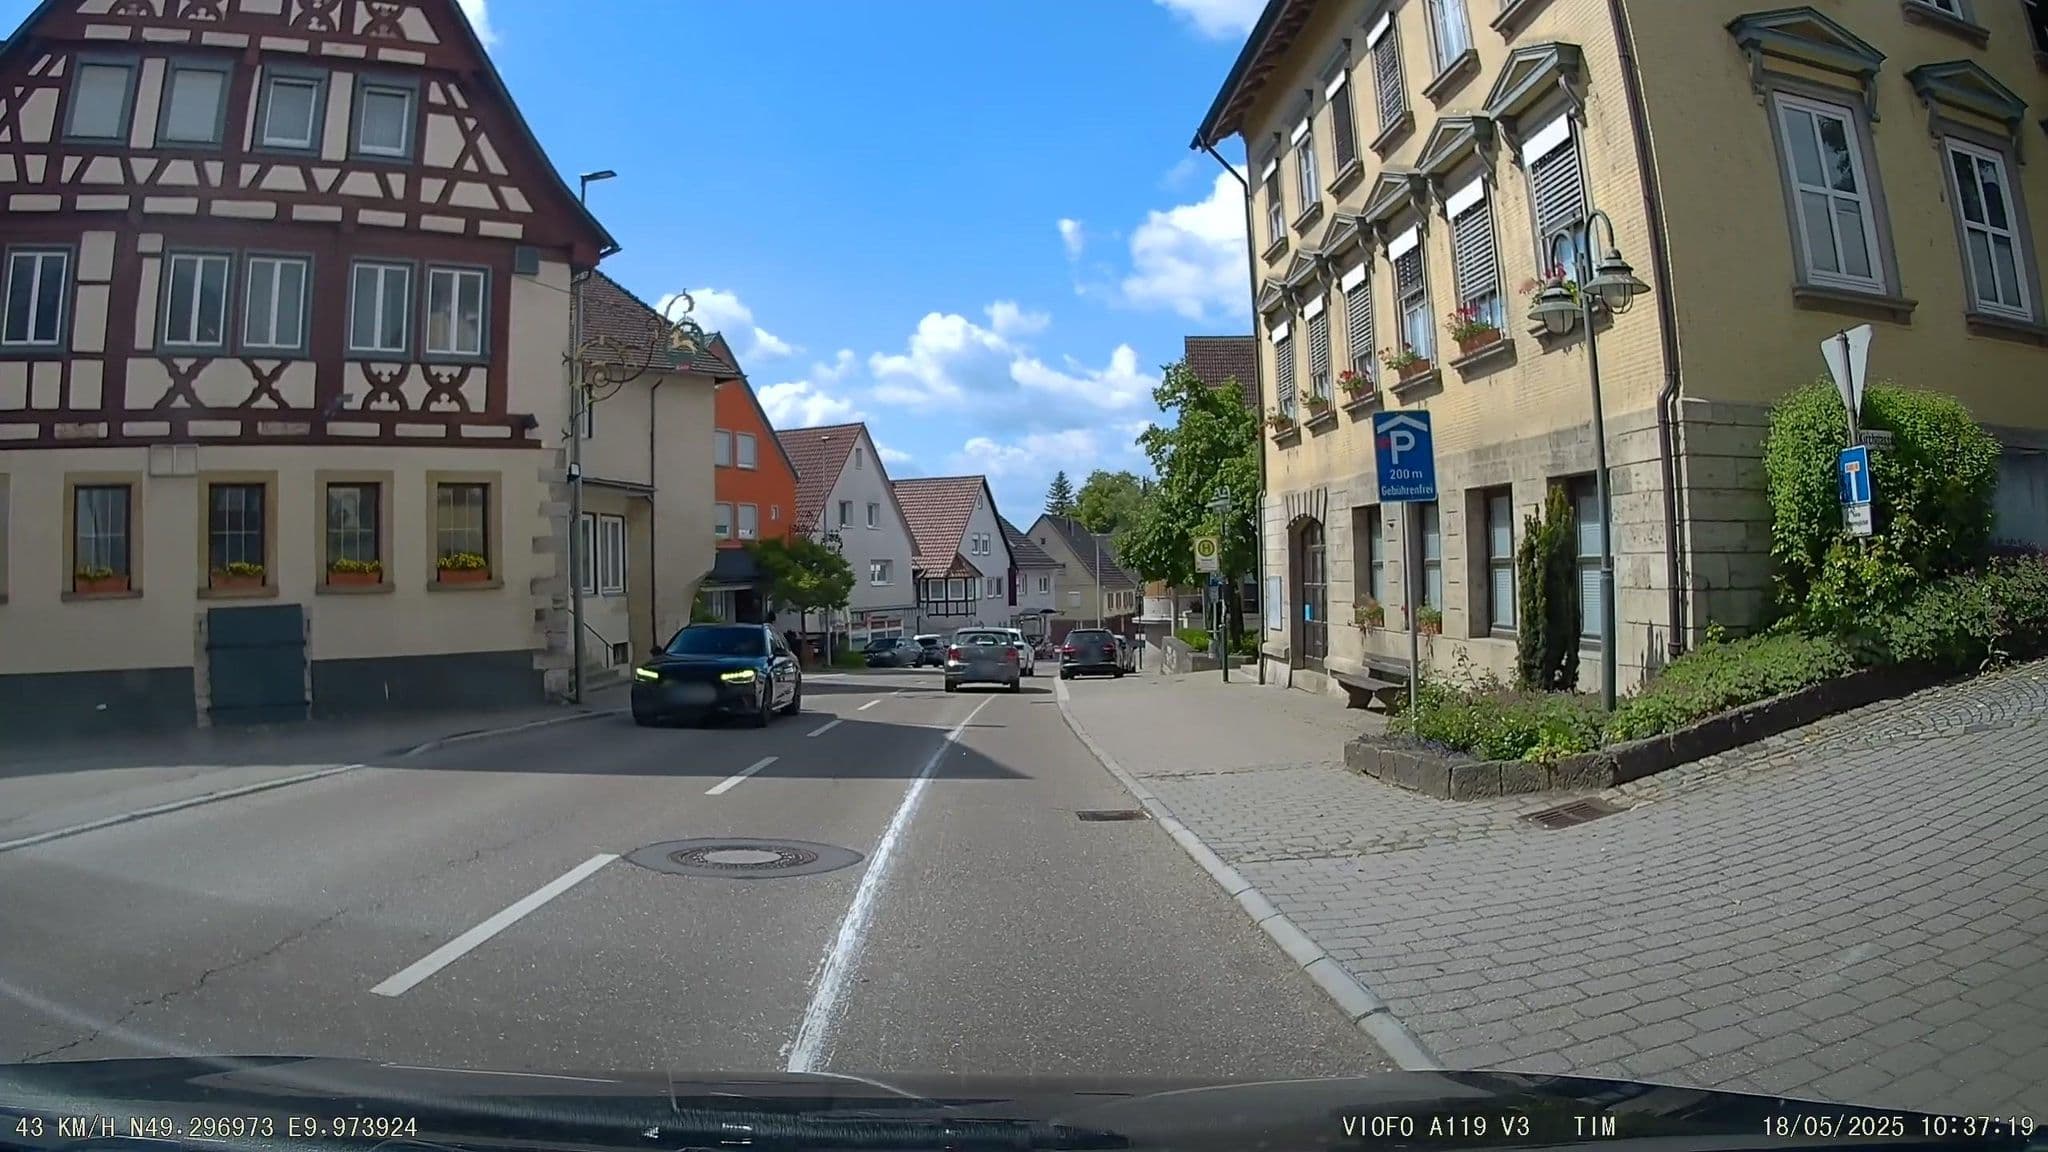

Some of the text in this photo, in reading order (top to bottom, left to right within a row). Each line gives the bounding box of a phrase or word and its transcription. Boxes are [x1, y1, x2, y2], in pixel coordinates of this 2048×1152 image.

[1390, 430, 1416, 465] P
[1390, 468, 1423, 480] 200 m
